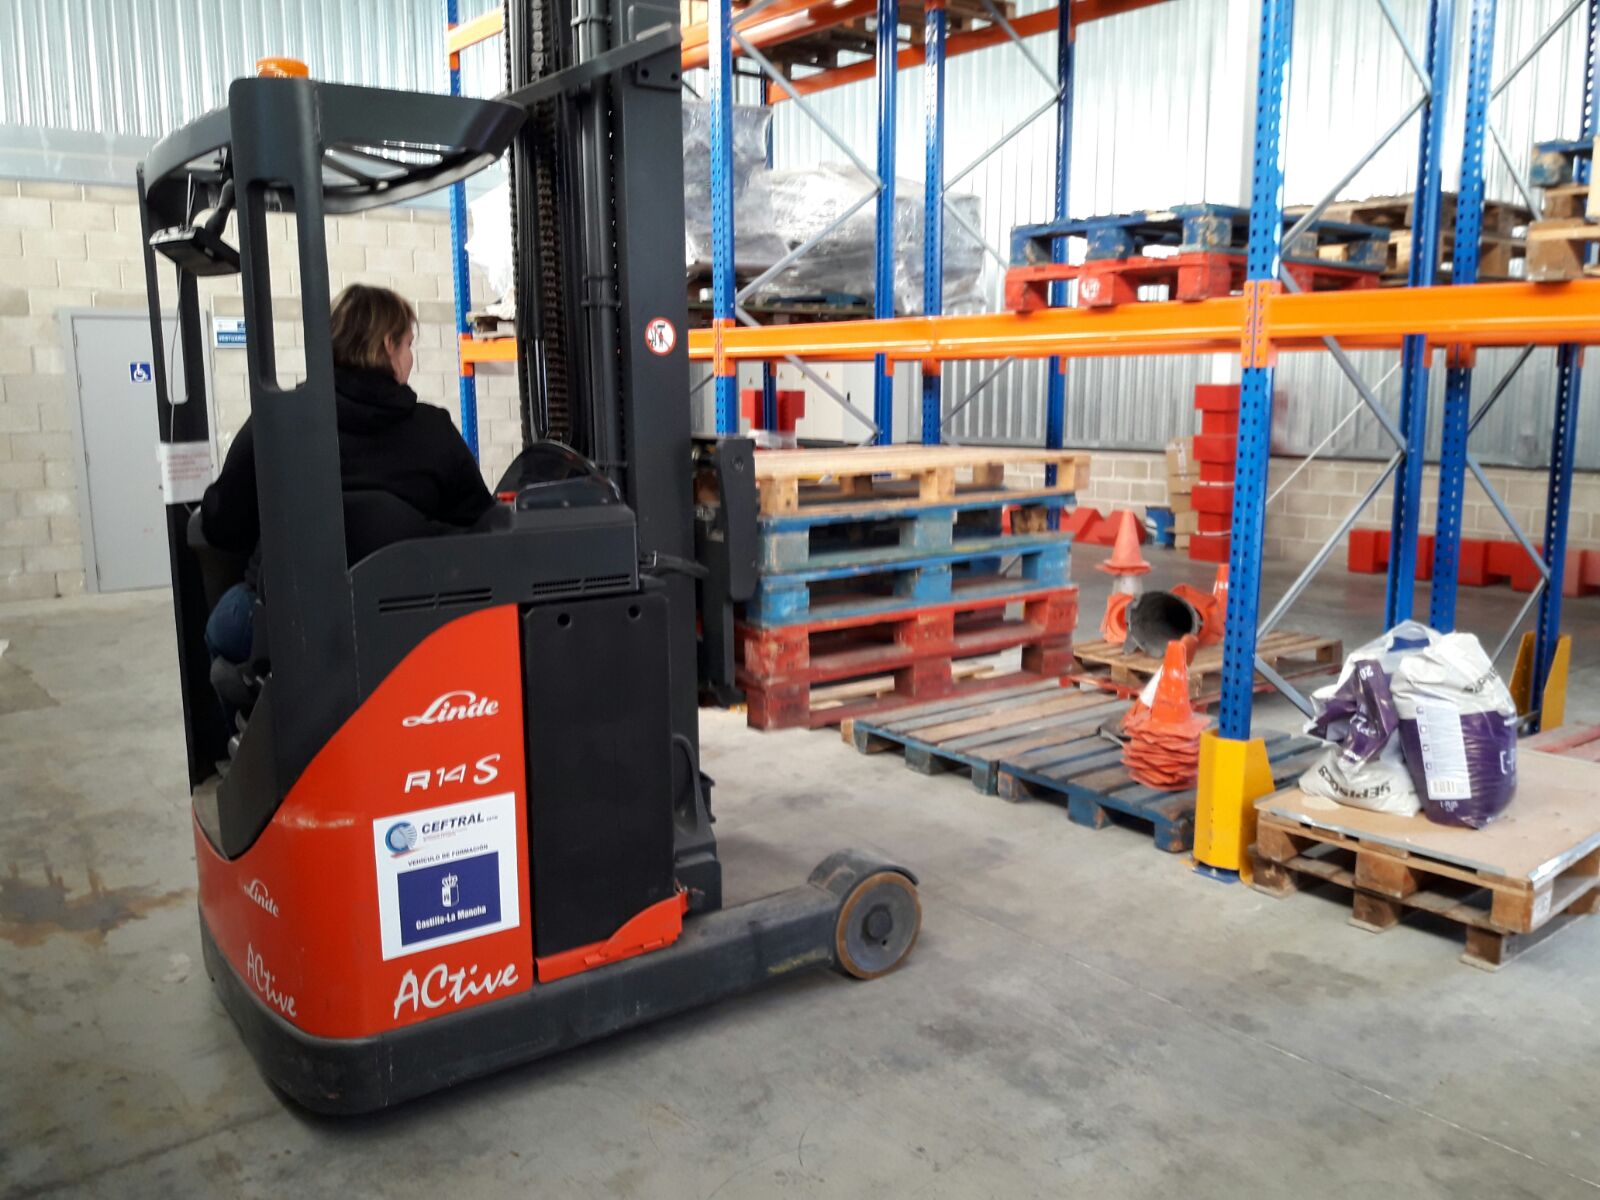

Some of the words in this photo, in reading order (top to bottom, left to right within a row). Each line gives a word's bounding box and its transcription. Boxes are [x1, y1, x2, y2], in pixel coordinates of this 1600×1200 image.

[402, 690, 499, 727] Linde
[473, 753, 501, 785] S
[421, 812, 484, 834] CEFTRAL
[243, 878, 279, 917] Linde
[457, 904, 487, 921] Mancha
[247, 941, 297, 1018] ACtive
[393, 963, 518, 1020] ACtive
